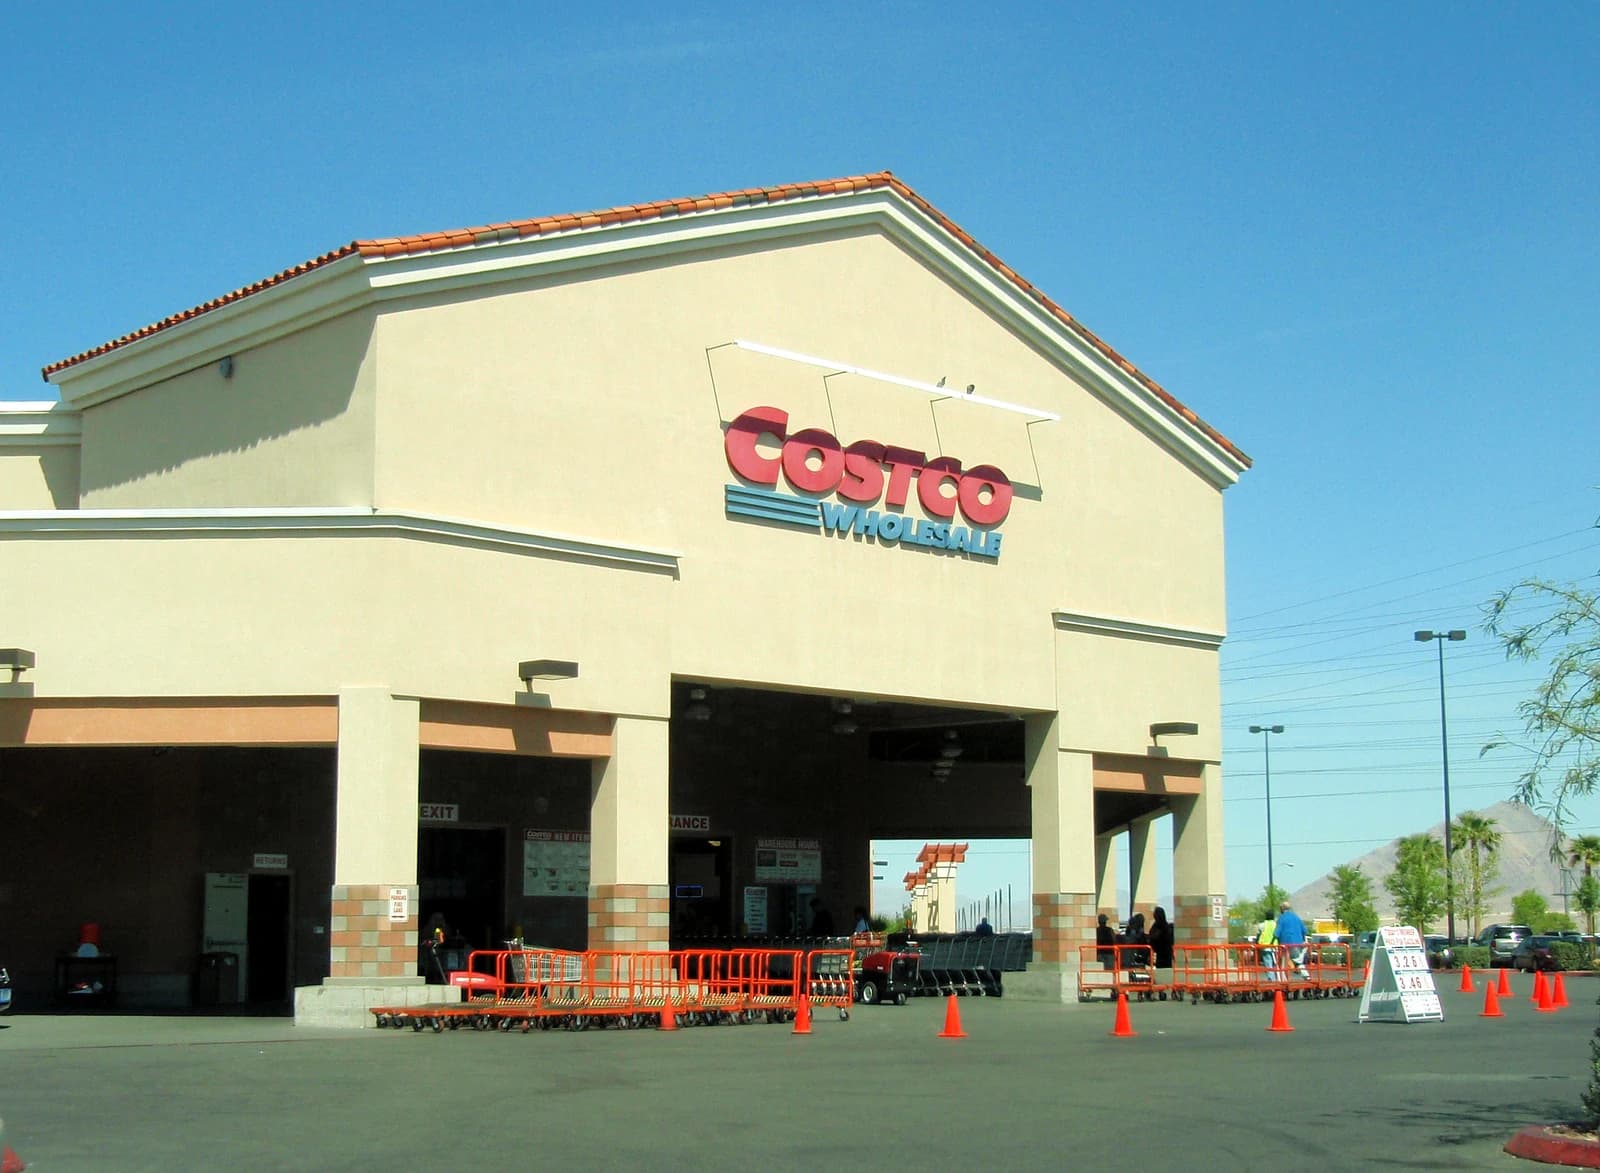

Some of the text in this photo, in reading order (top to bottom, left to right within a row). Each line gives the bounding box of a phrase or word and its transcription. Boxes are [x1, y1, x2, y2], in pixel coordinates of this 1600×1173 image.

[725, 405, 1013, 526] COSTCO
[819, 500, 1003, 558] WHOLESALE
[420, 805, 454, 819] EXIT
